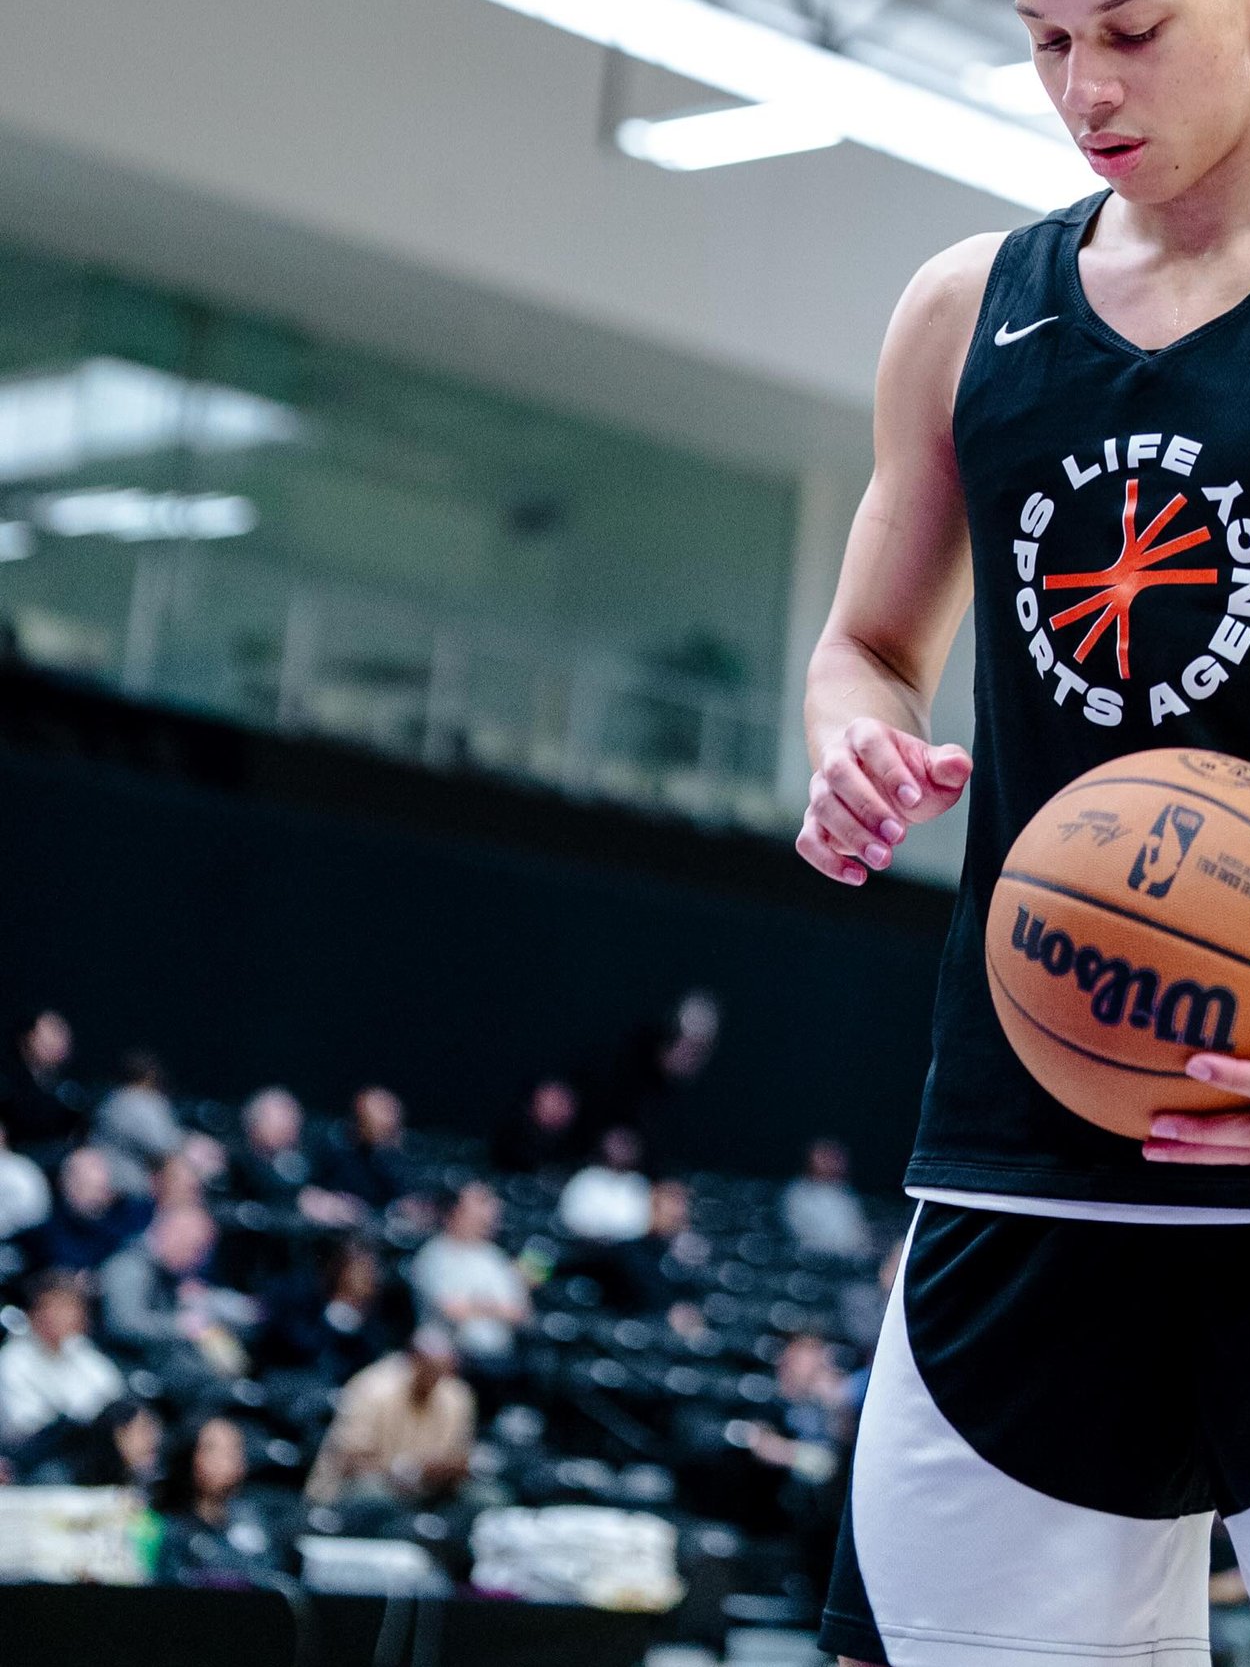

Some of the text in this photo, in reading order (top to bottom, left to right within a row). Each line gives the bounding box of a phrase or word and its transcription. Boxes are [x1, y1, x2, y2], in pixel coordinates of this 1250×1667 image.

[1062, 433, 1203, 490] LIFE
[1013, 492, 1123, 726] SPORTS
[1011, 902, 1237, 1052] Wilson
